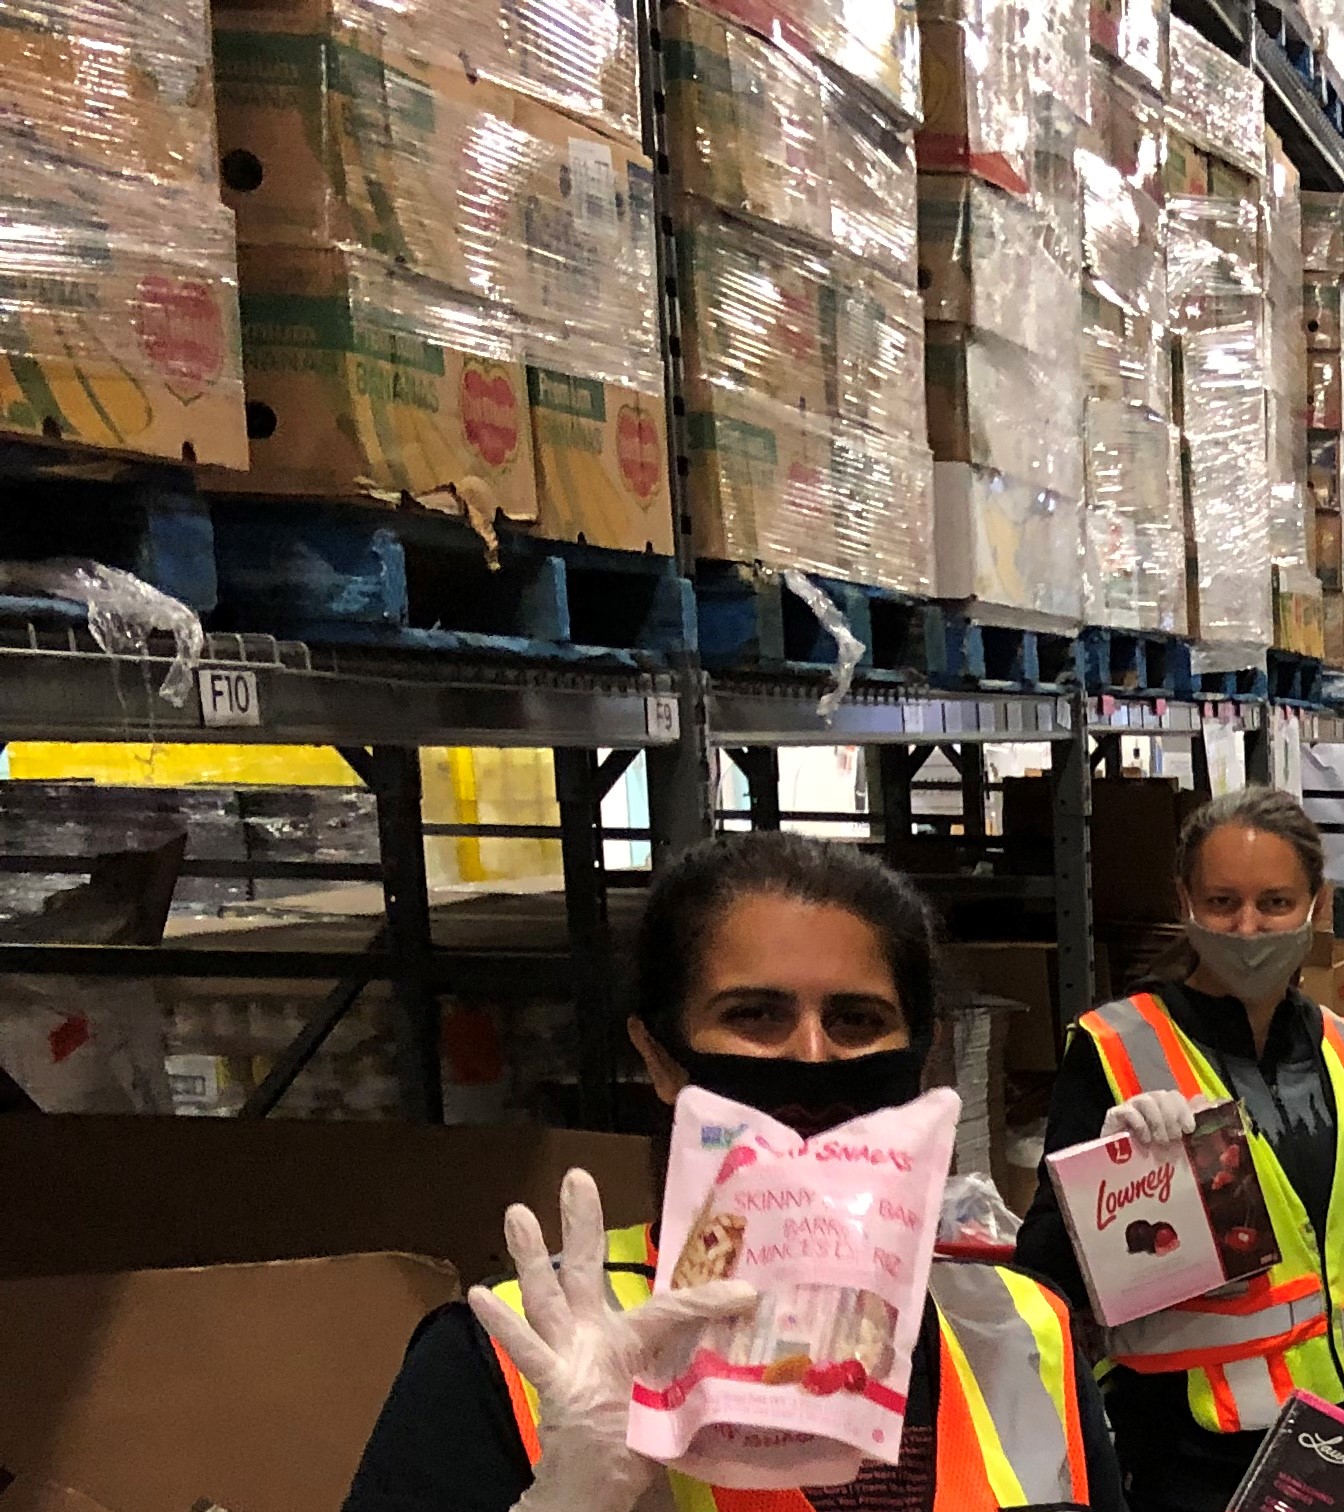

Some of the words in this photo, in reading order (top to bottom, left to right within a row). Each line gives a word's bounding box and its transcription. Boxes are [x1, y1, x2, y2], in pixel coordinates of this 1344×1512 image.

[211, 676, 250, 714] F10
[656, 702, 672, 732] F9
[1097, 1162, 1174, 1230] Lowney
